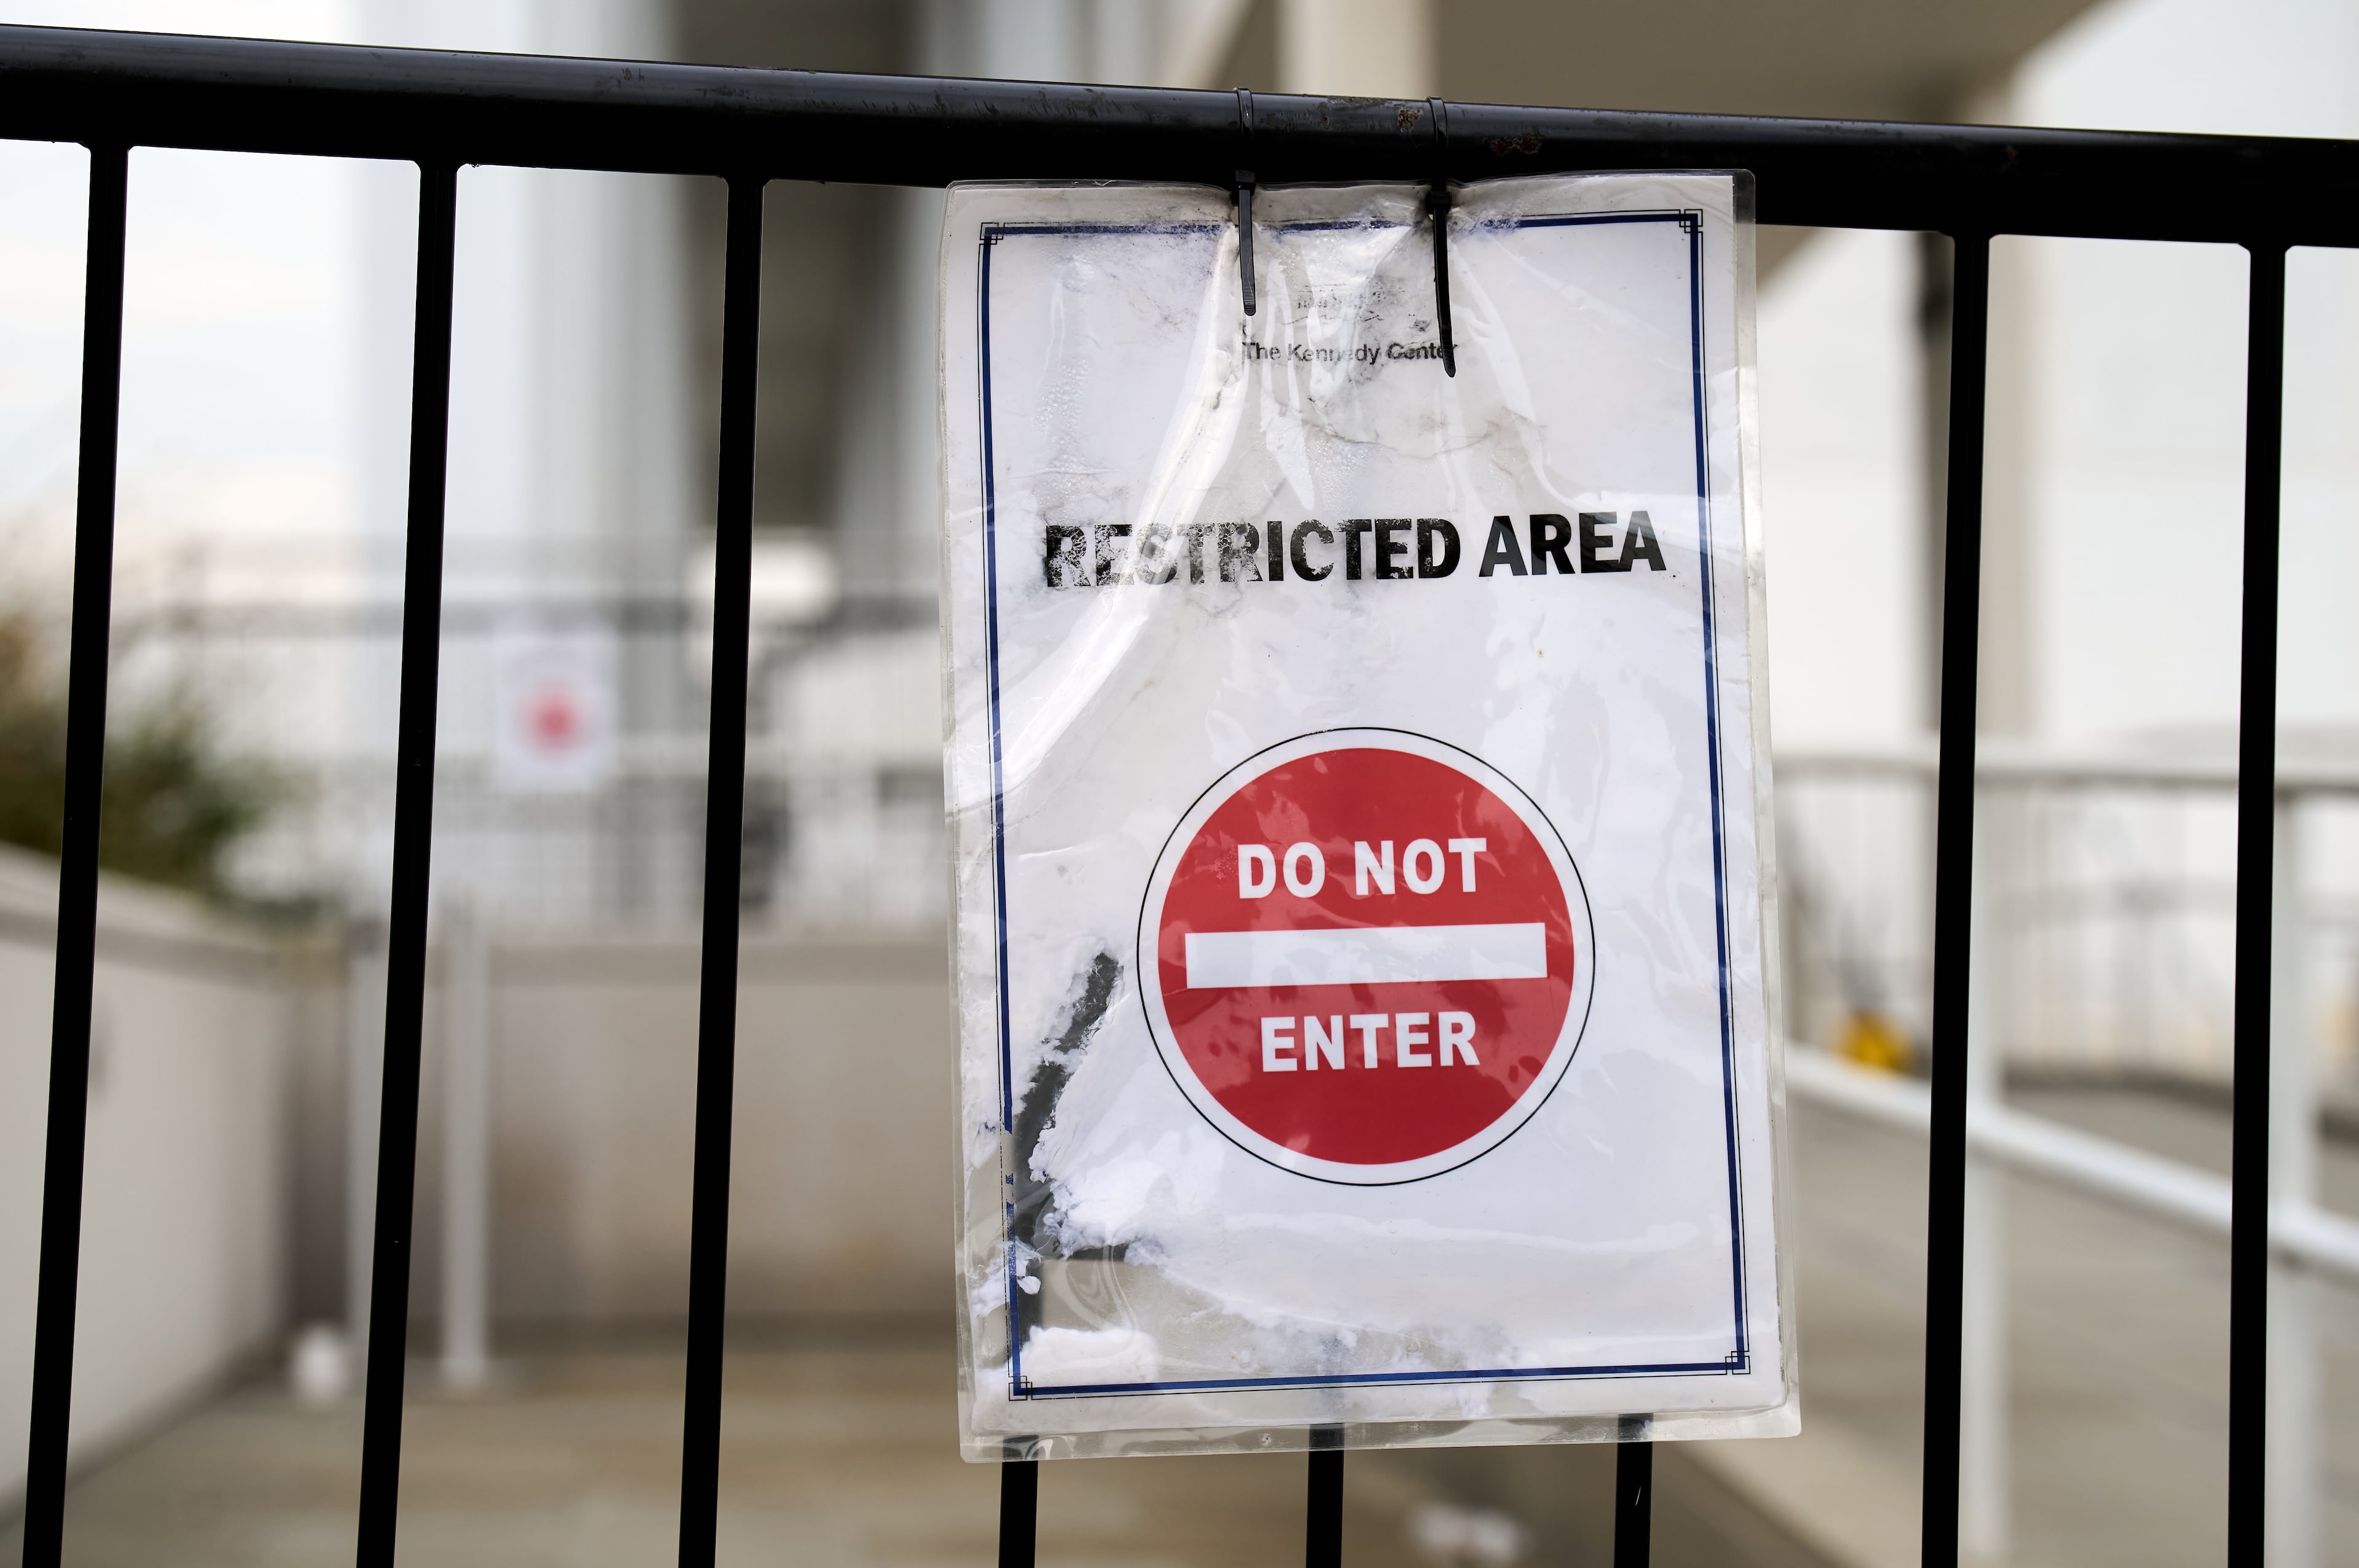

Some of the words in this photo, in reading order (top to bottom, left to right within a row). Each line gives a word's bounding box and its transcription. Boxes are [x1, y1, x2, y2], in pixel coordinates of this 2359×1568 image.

[1242, 341, 1281, 361] The
[1046, 518, 1461, 588] RESTRICTED
[1478, 510, 1667, 577] AREA
[1237, 841, 1326, 899] DO
[1354, 837, 1487, 896] NOT
[1260, 1011, 1481, 1072] ENTER
